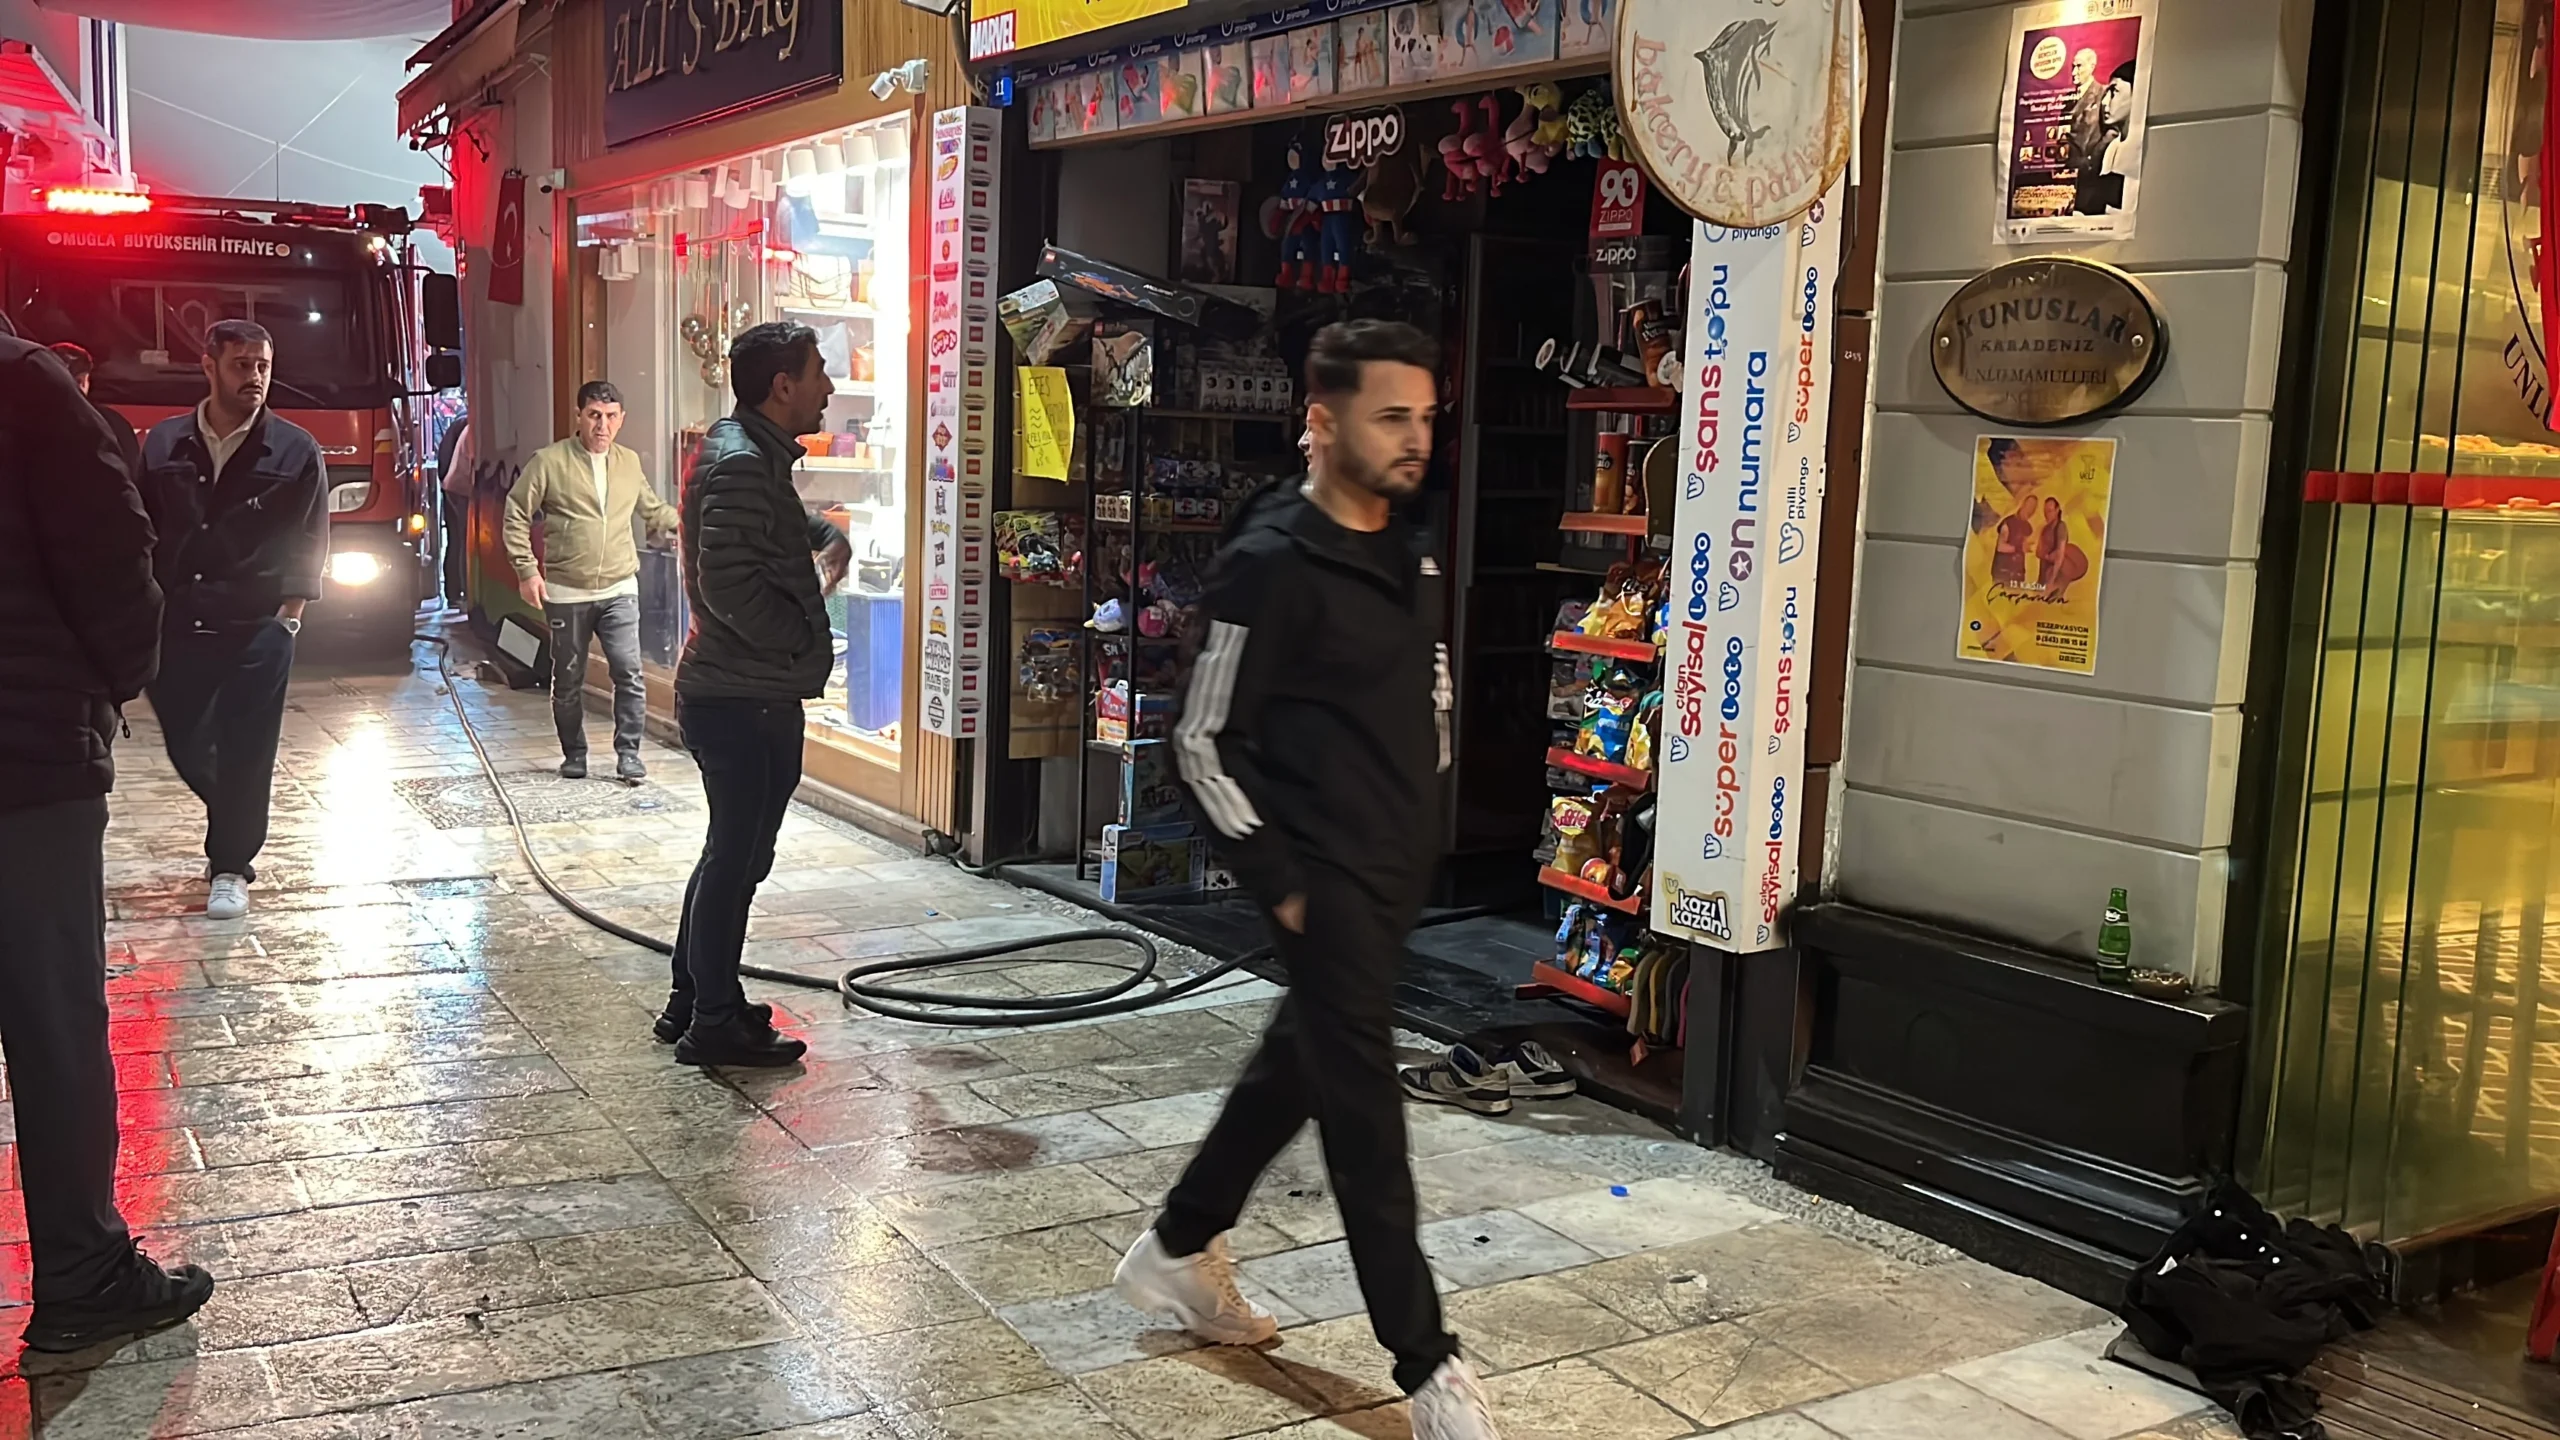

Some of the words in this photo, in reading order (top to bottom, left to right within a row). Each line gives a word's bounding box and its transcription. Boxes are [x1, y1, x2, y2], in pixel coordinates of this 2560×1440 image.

[971, 12, 1015, 58] MARVEL
[1599, 209, 1634, 223] ZIPPO
[124, 234, 217, 252] BÜYÜKŞEHİR
[221, 236, 275, 256] İTFAİYE
[1957, 297, 2128, 344] YUNUSLAR
[1738, 351, 1768, 512] numara
[1796, 457, 1809, 519] piyango
[2037, 621, 2089, 633] REZERVASYON
[925, 640, 951, 657] STAR
[925, 652, 951, 674] WARS
